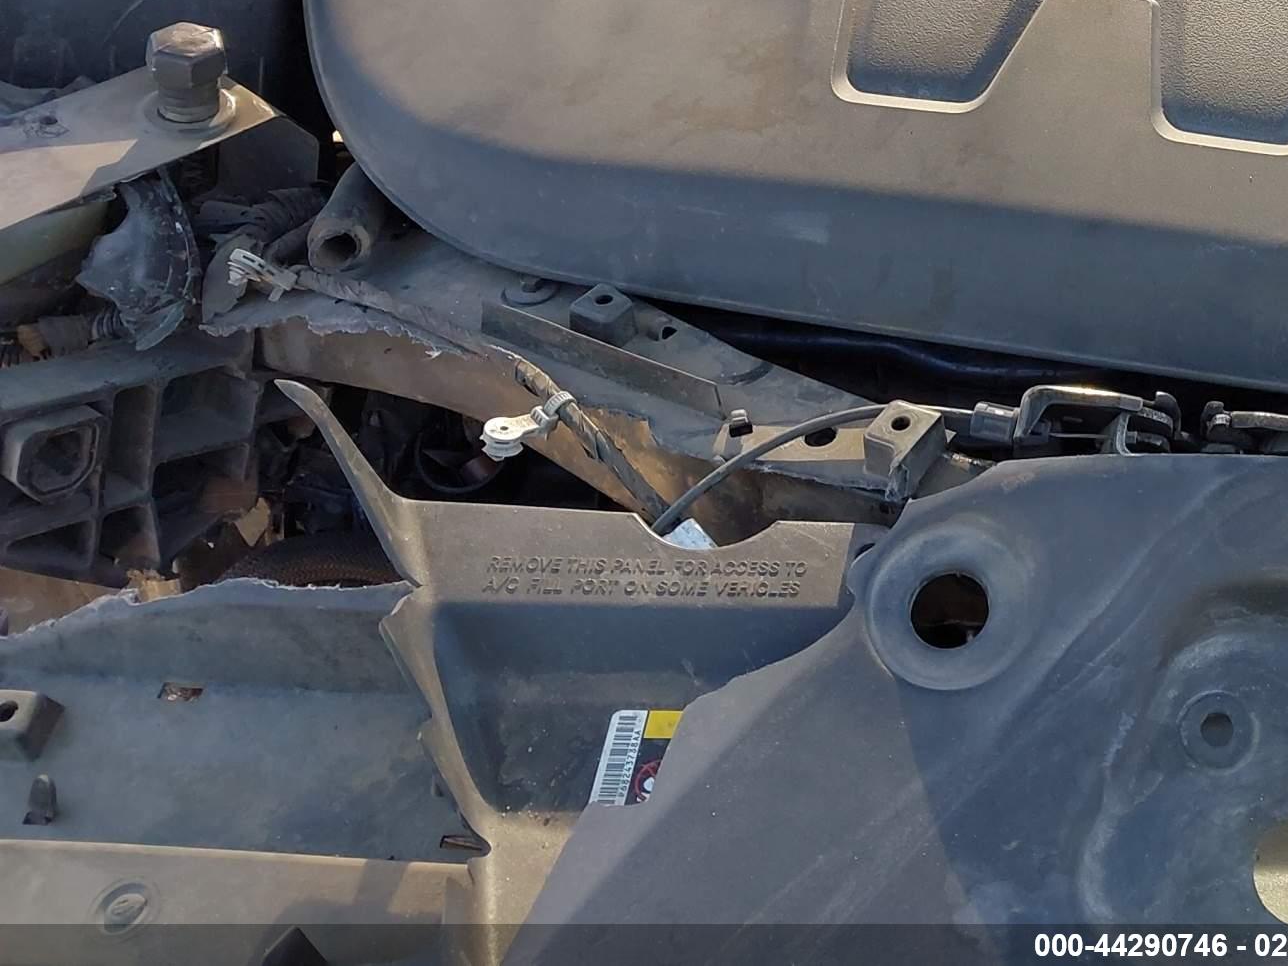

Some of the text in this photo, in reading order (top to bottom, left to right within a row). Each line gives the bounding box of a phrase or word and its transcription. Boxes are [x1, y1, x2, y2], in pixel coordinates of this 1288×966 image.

[487, 555, 808, 579] REMOVE THIS PANEL FOR ACCESS TO
[481, 575, 801, 599] A/C FILL PORT ON SOME VEHICLES
